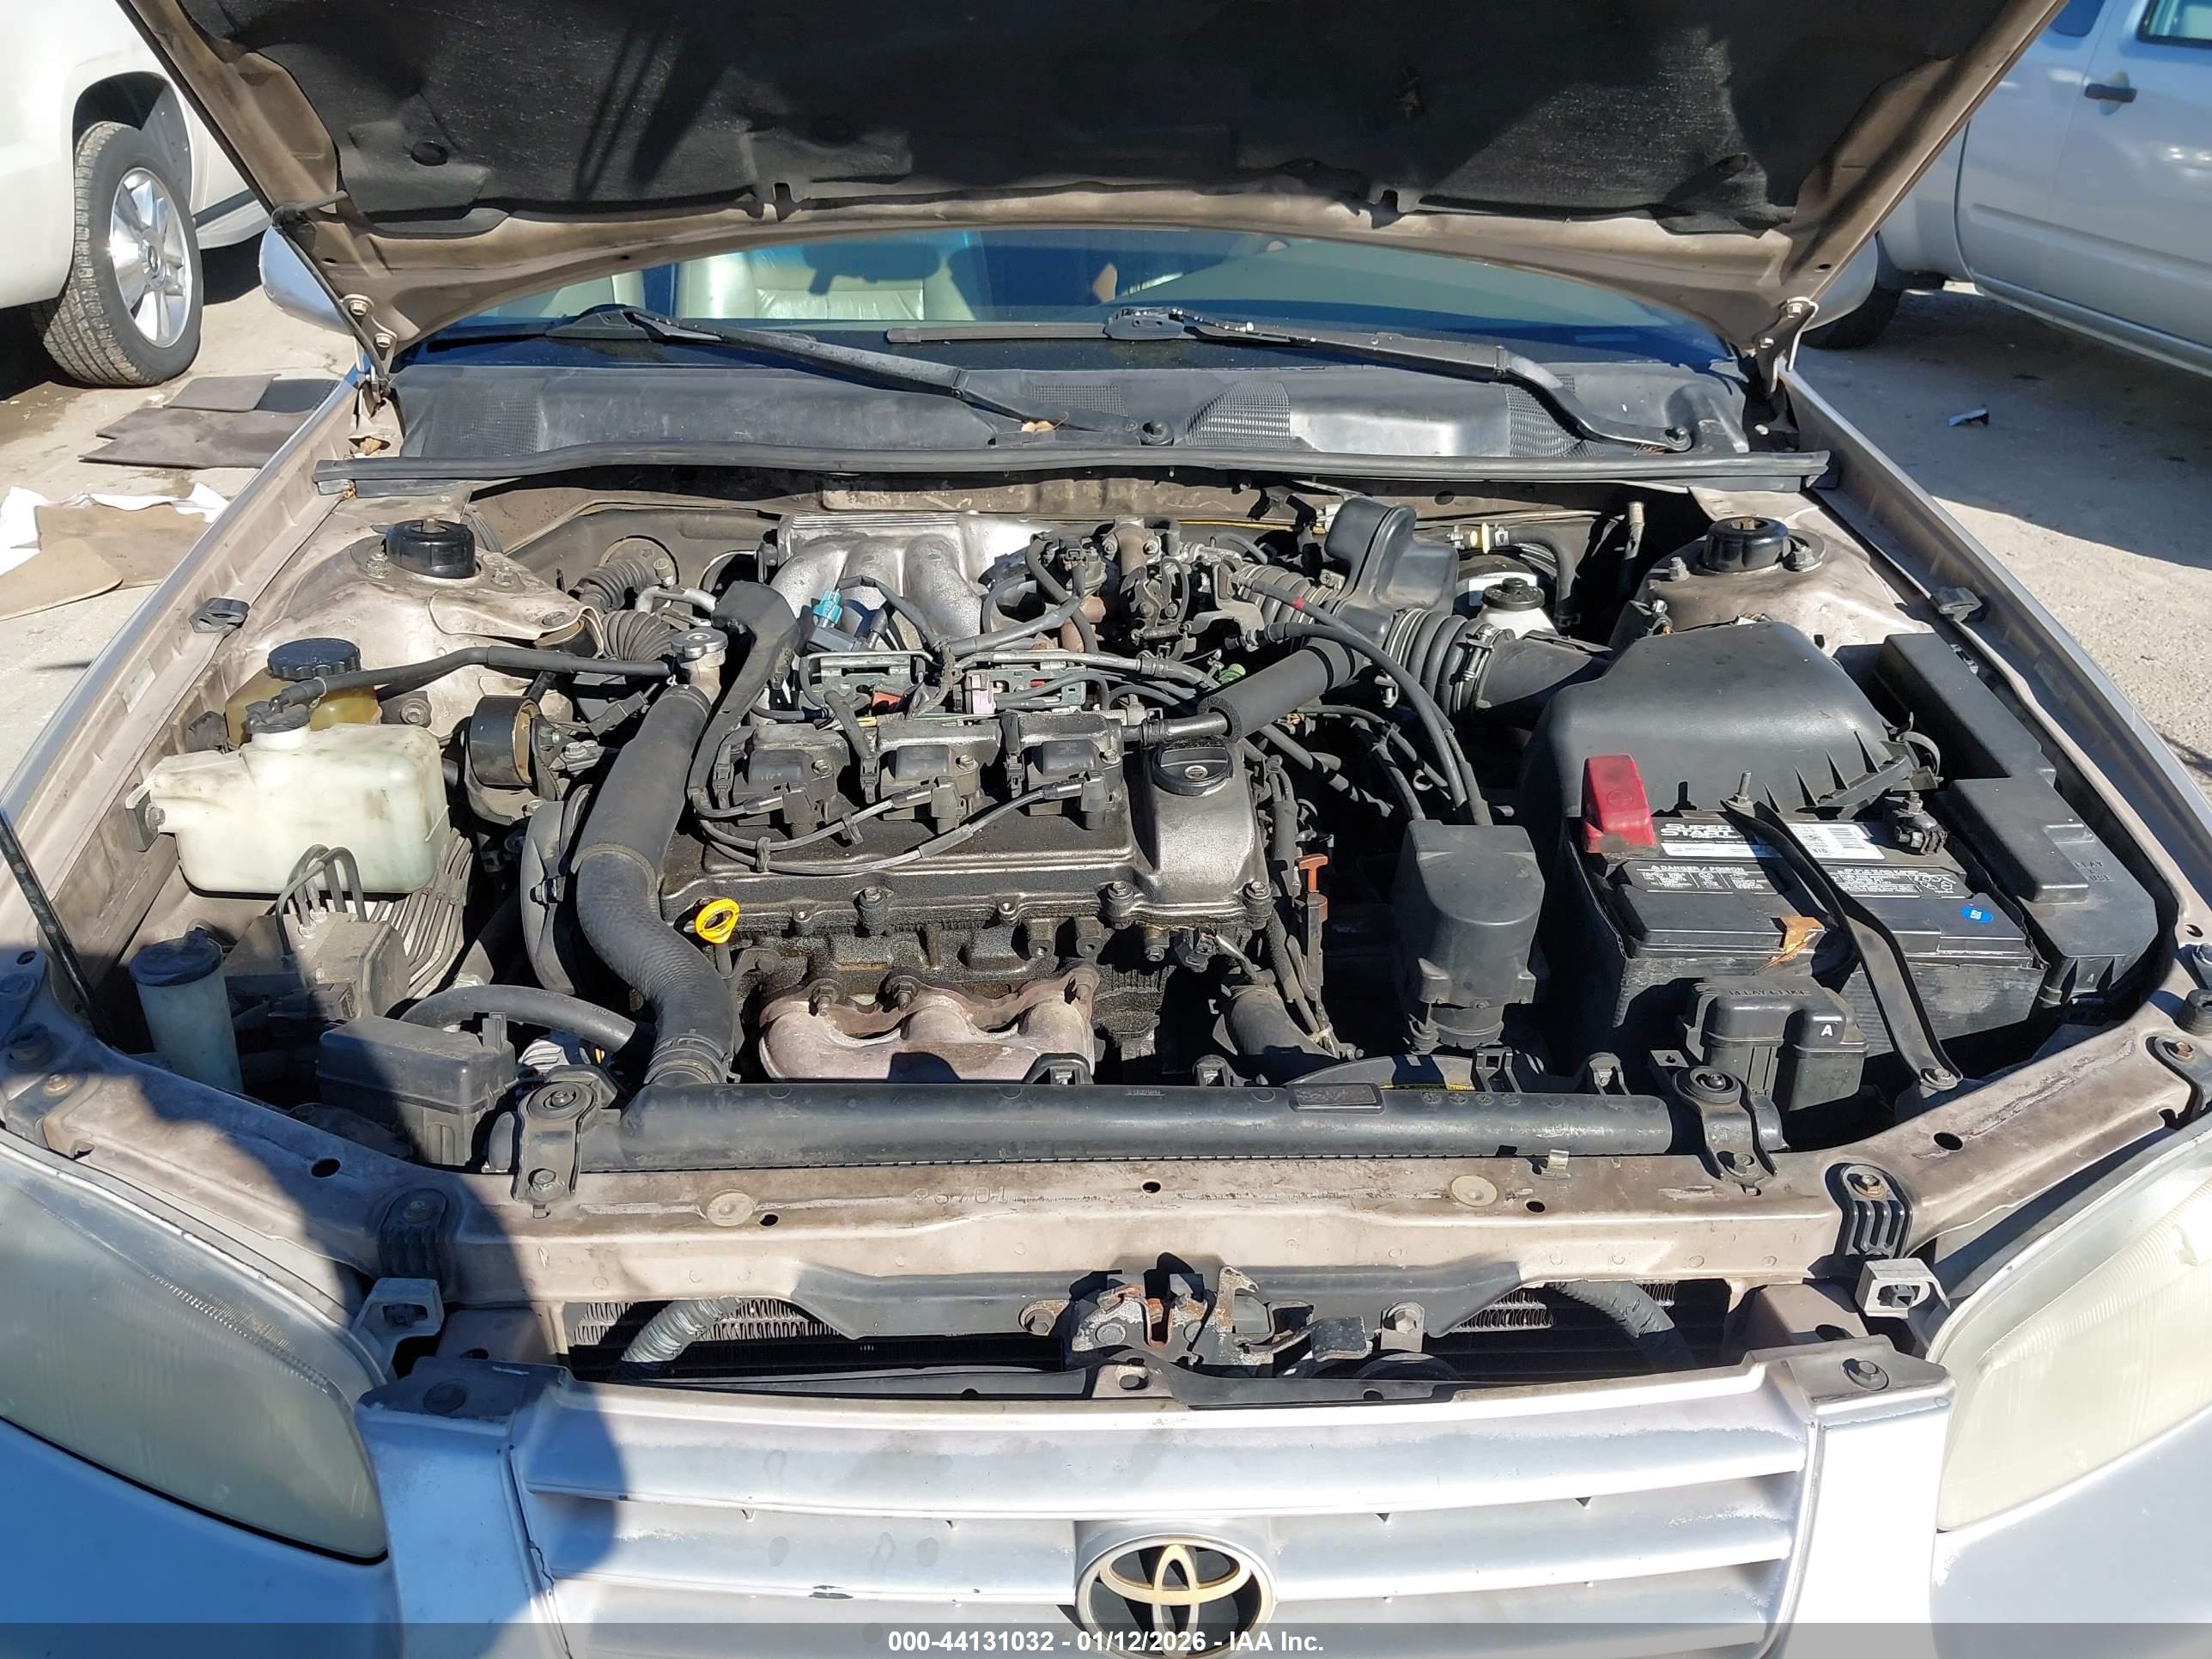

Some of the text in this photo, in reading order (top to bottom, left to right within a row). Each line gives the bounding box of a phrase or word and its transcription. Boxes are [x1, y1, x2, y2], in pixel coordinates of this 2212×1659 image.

[1665, 823, 1731, 831] SUPER
[1661, 828, 1734, 837] START
[1820, 1024, 1833, 1036] A
